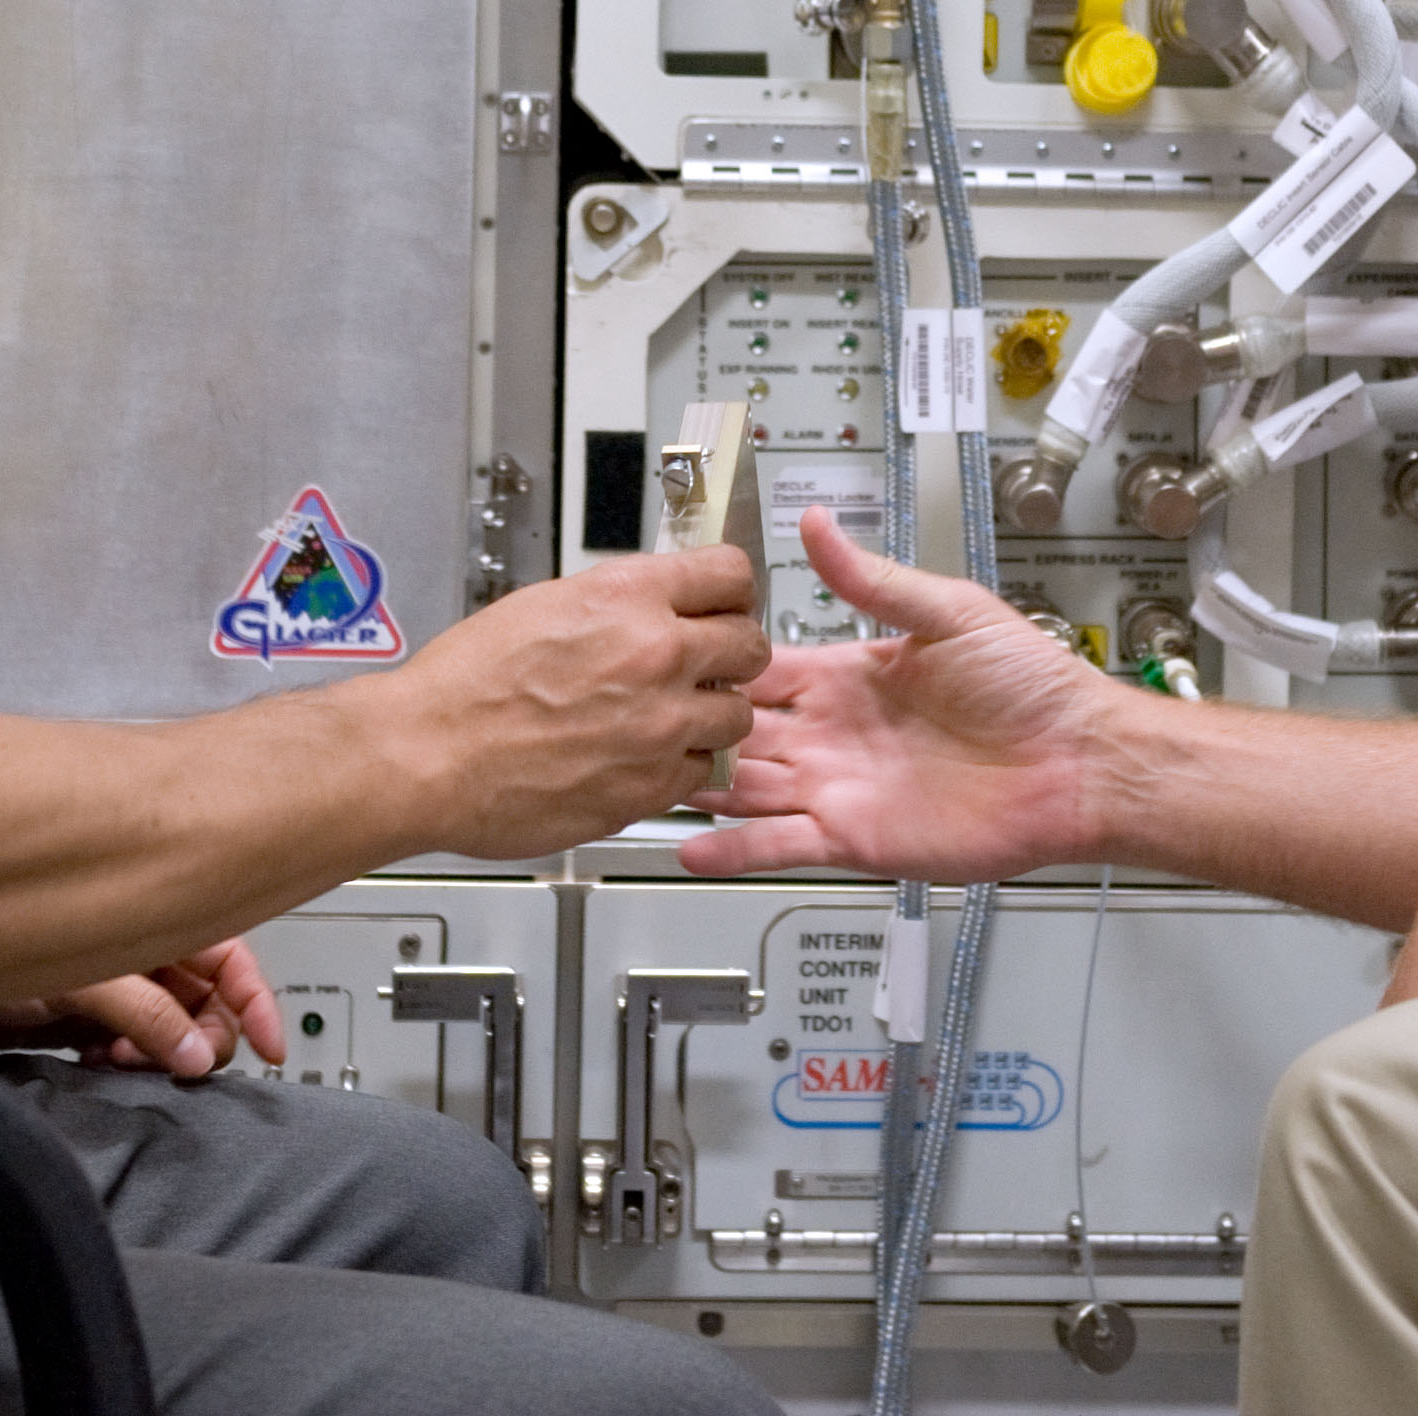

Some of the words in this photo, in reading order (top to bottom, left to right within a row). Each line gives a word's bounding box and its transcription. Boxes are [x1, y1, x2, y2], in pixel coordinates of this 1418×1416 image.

[728, 319, 769, 329] INSERT
[697, 316, 707, 395] STATUS
[783, 430, 824, 440] ALARM
[773, 493, 834, 503] Electronics
[837, 493, 875, 503] Locker
[799, 959, 881, 979] CONTR
[799, 988, 847, 1006] UNIT
[804, 1057, 890, 1093] SAM
